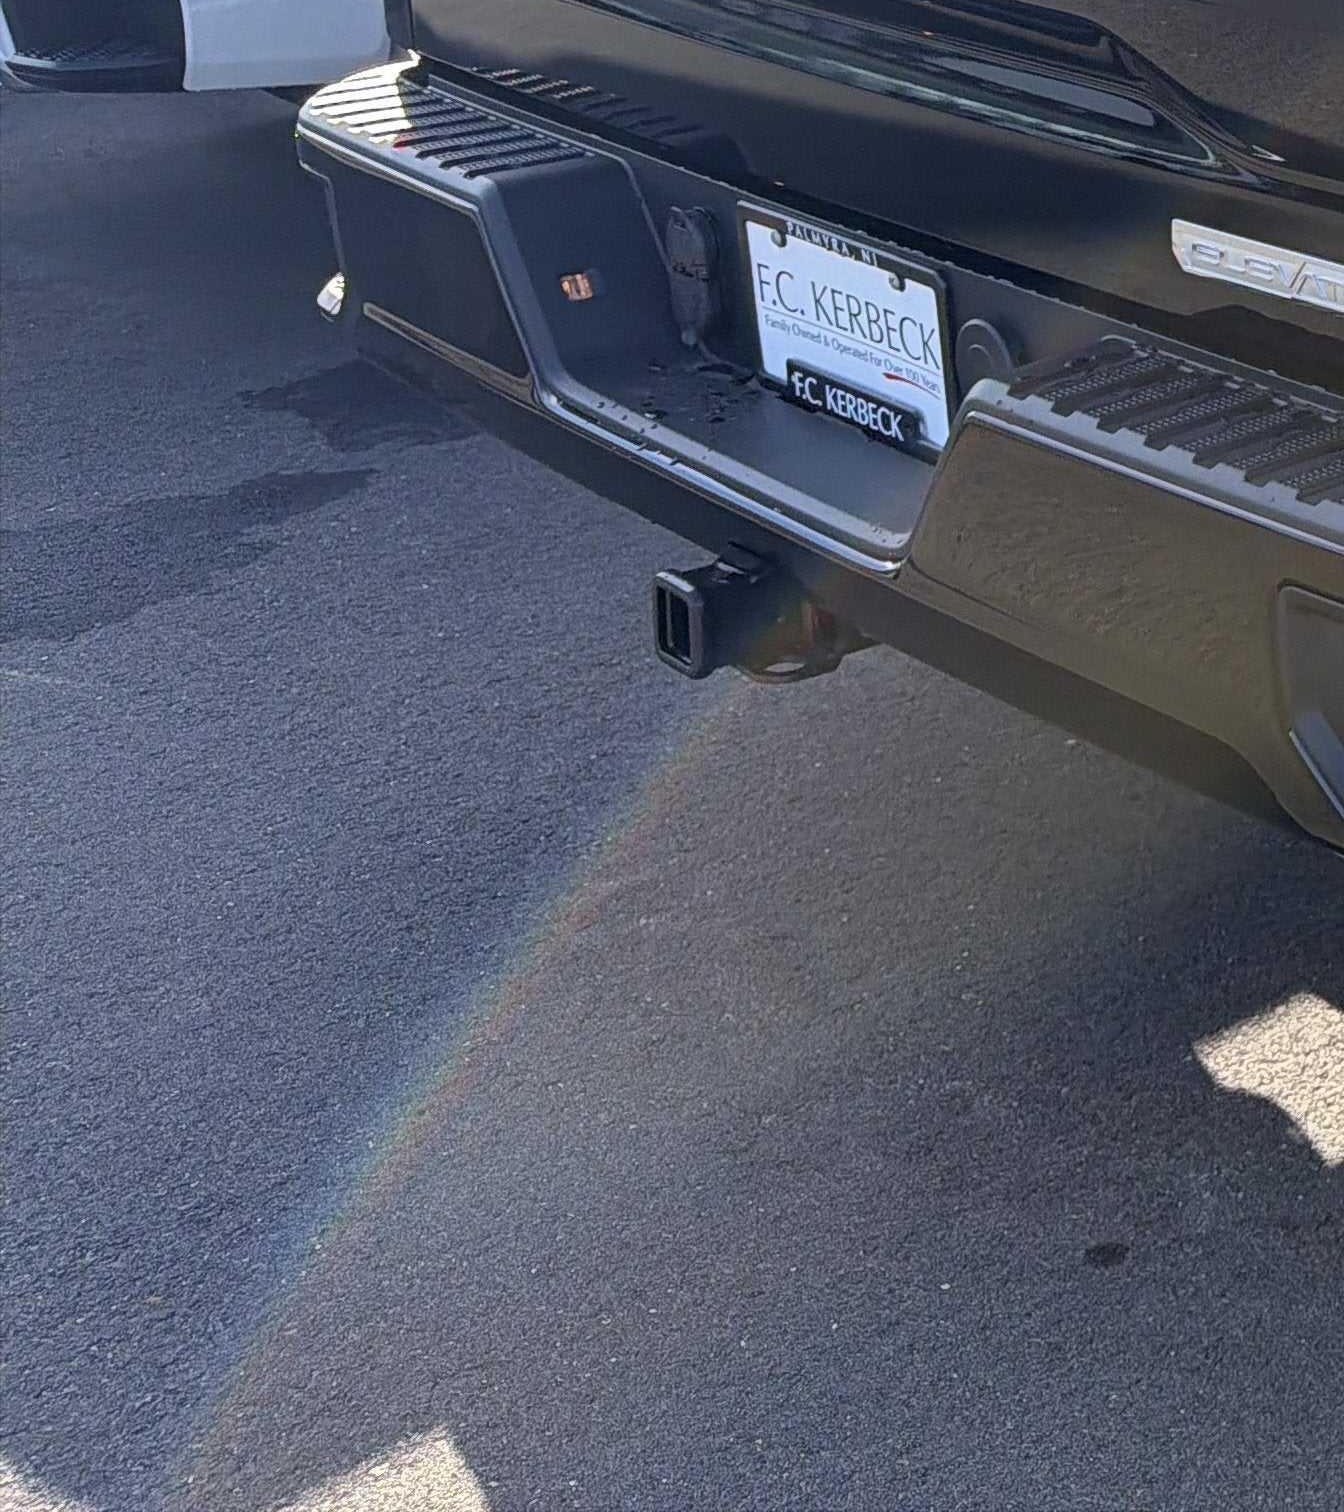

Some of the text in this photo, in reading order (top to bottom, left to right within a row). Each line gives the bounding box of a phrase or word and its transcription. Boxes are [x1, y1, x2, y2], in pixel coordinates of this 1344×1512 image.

[757, 263, 941, 370] F.C. KERBECK
[793, 371, 904, 442] F.C. KERBECK
